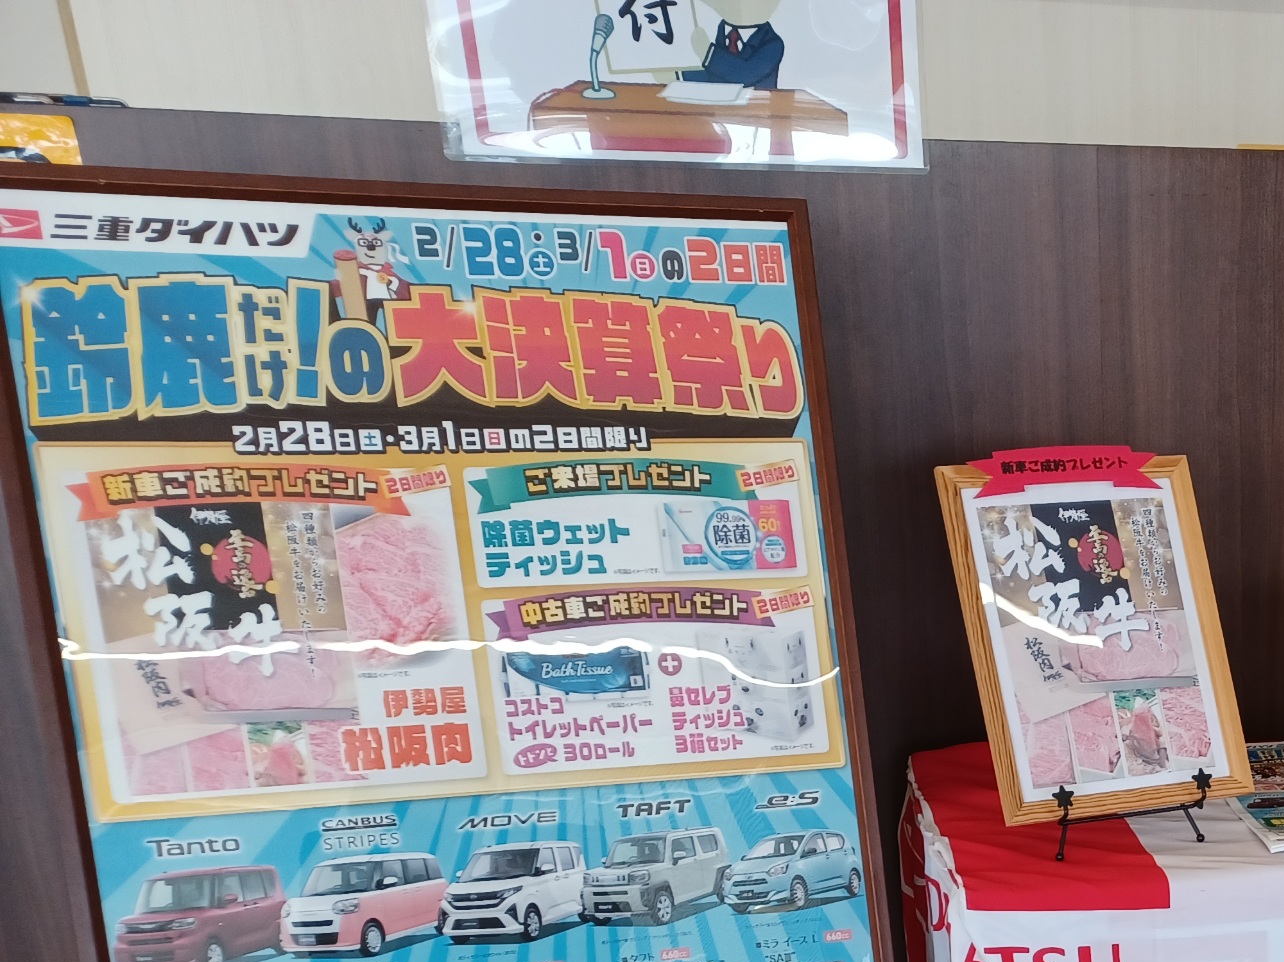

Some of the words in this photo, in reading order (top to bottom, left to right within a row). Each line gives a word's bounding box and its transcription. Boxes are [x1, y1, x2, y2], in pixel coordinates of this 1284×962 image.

[49, 213, 300, 247] 三重ダイハツ
[1000, 457, 1129, 475] 新車ご成約プレゼント
[101, 466, 379, 506] 新車ご成約プレゼント
[384, 469, 447, 494] 2日間限り
[523, 463, 712, 496] ご来場プレゼント
[480, 517, 631, 549] 除菌ウェット
[713, 523, 752, 546] 除菌
[485, 550, 608, 578] ティッシュ
[519, 590, 750, 629] 中古車ご成約プレゼント
[541, 661, 576, 679] Bath
[575, 660, 614, 677] Tissue
[383, 686, 467, 718] 伊勢屋
[504, 696, 565, 718] コストコ
[507, 713, 653, 741] トイレットペーパー
[671, 708, 746, 731] ティッシュ
[341, 722, 473, 772] 松阪肉
[562, 740, 636, 762] 30ロール
[674, 732, 744, 754] 3箱セット
[616, 798, 692, 819] TAFT
[321, 814, 397, 832] CANBUS
[459, 810, 558, 831] MOVE
[146, 837, 241, 858] Tanto
[323, 832, 400, 851] STRIPES
